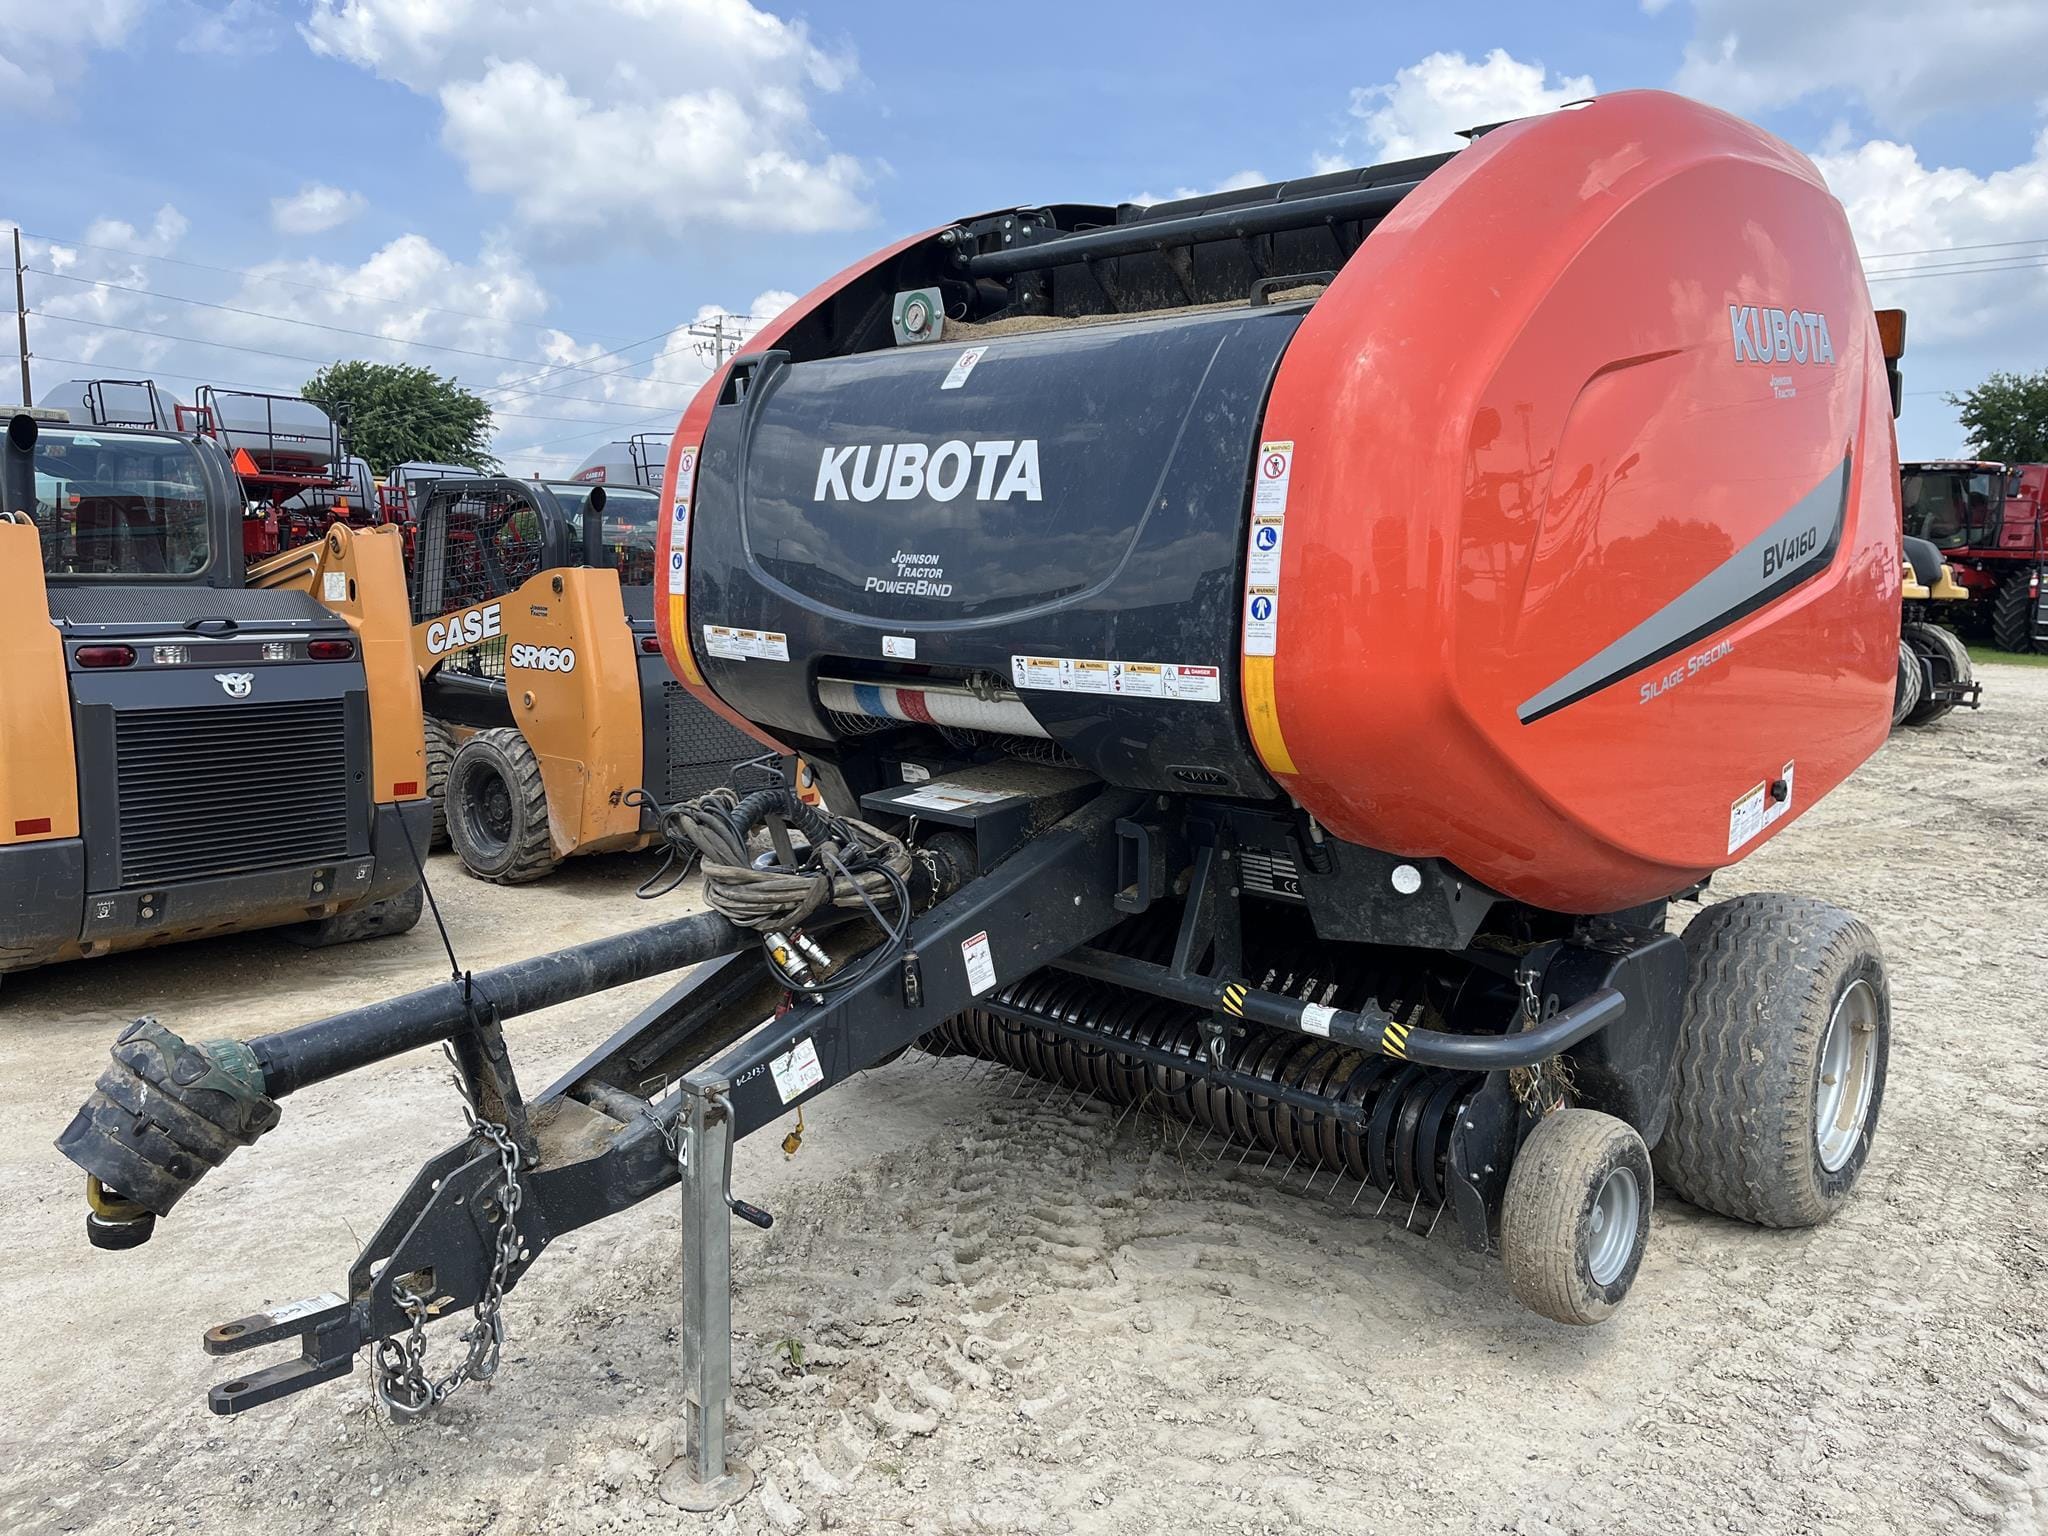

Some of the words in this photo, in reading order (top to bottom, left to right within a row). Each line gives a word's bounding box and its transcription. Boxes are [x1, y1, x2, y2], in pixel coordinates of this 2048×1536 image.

[1729, 304, 1836, 365] KUBOTA
[814, 439, 1043, 503] KUBOTA
[892, 550, 940, 565] JOHNSON
[897, 564, 943, 580] TRACTOR
[1763, 527, 1816, 579] BV4160
[426, 602, 501, 655] CASE
[510, 643, 576, 674] SR160
[1640, 667, 1685, 705] SILAGE
[1687, 638, 1735, 678] SPECIAL
